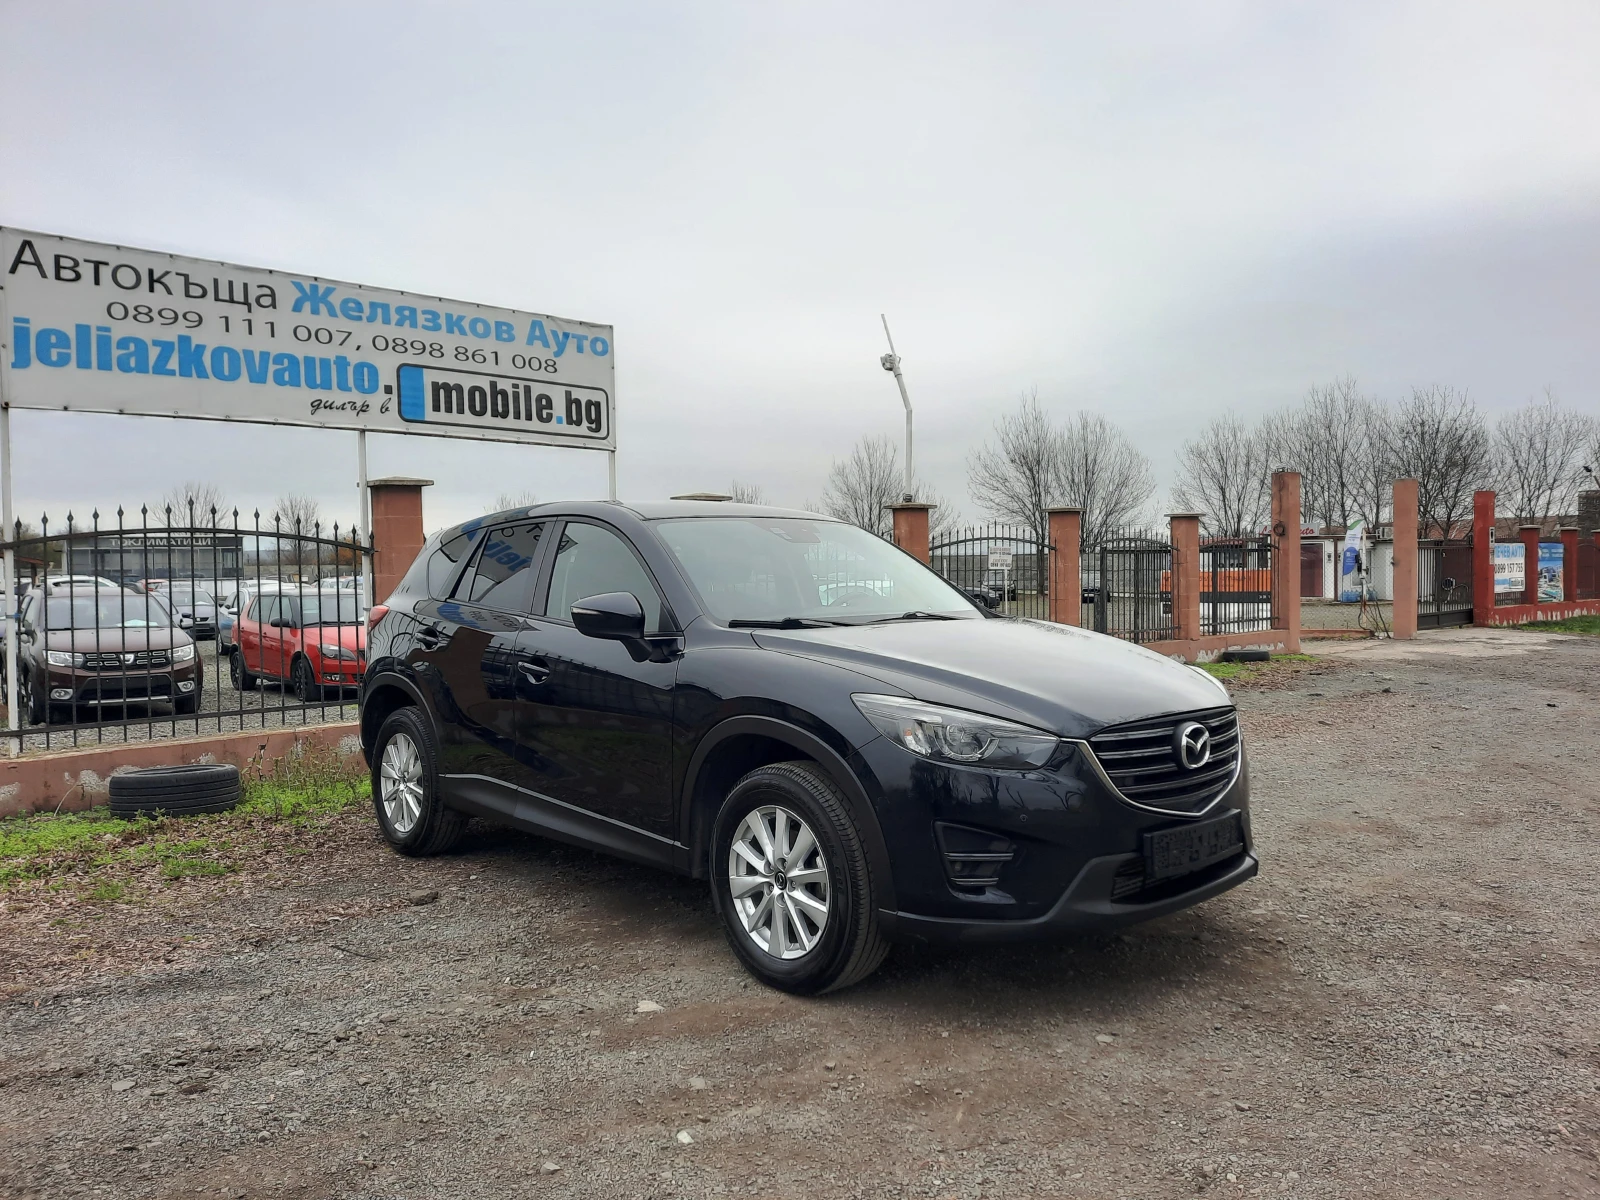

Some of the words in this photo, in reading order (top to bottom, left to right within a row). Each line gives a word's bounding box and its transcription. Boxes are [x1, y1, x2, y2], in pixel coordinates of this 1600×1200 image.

[9, 240, 277, 313] Автокъща
[290, 280, 516, 343] Желязков
[525, 319, 609, 358] Ауто
[106, 302, 203, 329] 0899
[219, 315, 275, 338] 111
[292, 325, 361, 352] 007,
[372, 335, 445, 359] 0898
[454, 346, 499, 366] 861
[512, 354, 558, 374] 008
[310, 398, 371, 417] дилър
[431, 380, 601, 433] mobile.bg
